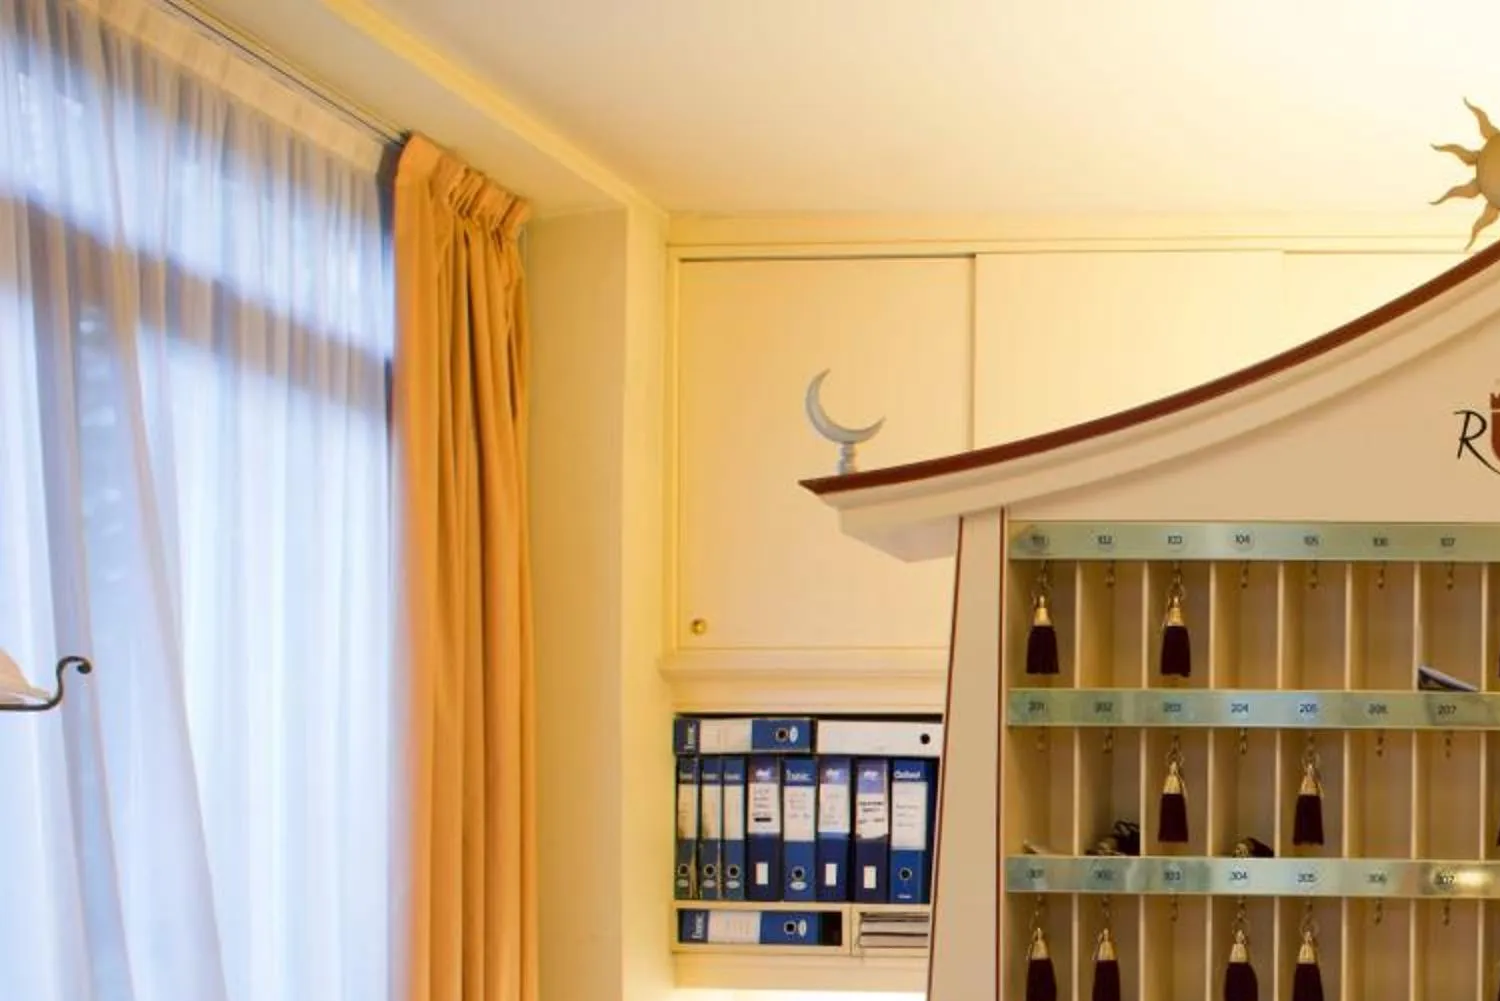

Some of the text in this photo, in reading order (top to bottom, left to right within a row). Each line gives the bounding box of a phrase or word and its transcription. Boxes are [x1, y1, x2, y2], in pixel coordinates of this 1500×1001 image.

[1231, 703, 1248, 712] 204
[1438, 705, 1456, 715] 207
[1231, 871, 1247, 880] 304
